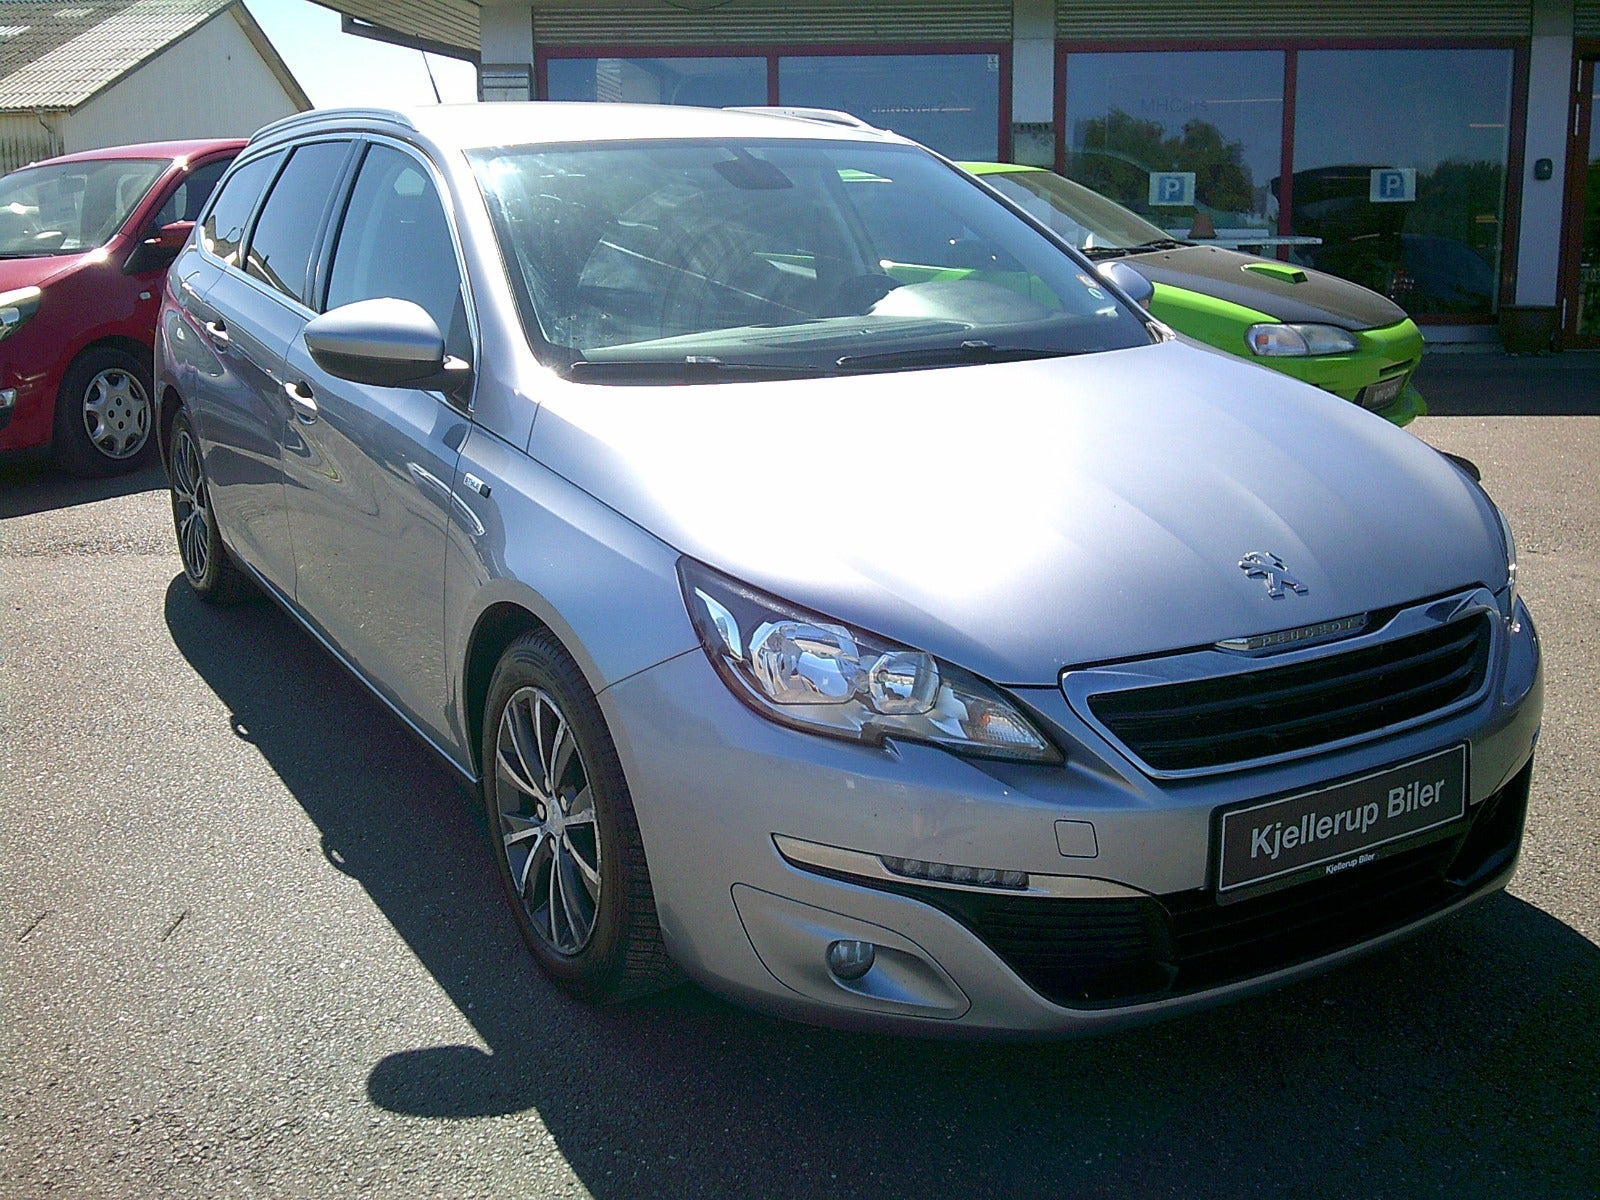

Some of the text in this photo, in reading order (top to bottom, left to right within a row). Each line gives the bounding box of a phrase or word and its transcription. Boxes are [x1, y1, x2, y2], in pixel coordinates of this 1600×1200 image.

[1165, 178, 1180, 200] P
[1385, 174, 1401, 197] P
[1262, 619, 1354, 647] PEUGEOT
[1250, 779, 1445, 860] Kjellerup Biler
[1325, 853, 1376, 874] Kjellerup Biler
